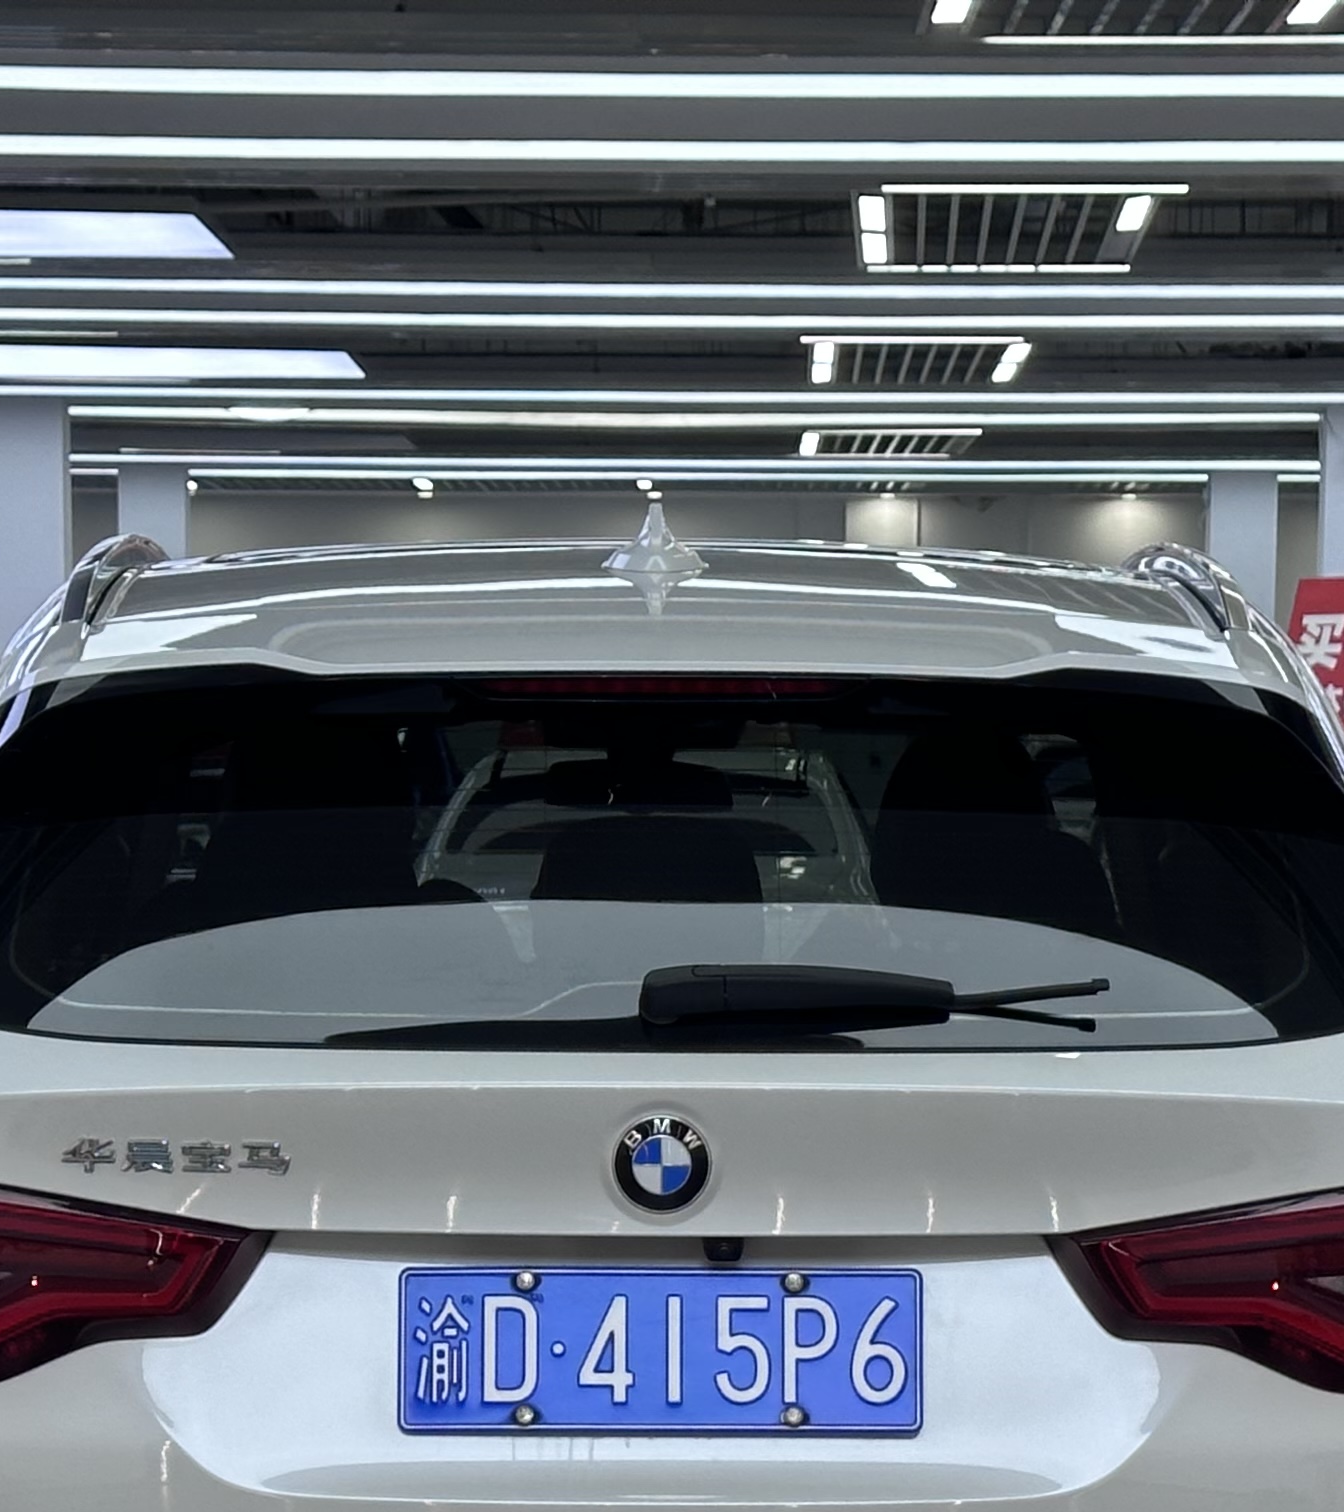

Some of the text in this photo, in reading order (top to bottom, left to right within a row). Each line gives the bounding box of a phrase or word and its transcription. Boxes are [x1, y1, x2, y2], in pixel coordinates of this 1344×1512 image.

[623, 1118, 703, 1150] BMW
[61, 1138, 292, 1176] 华晨宝马
[415, 1294, 908, 1406] 渝D·415P6
